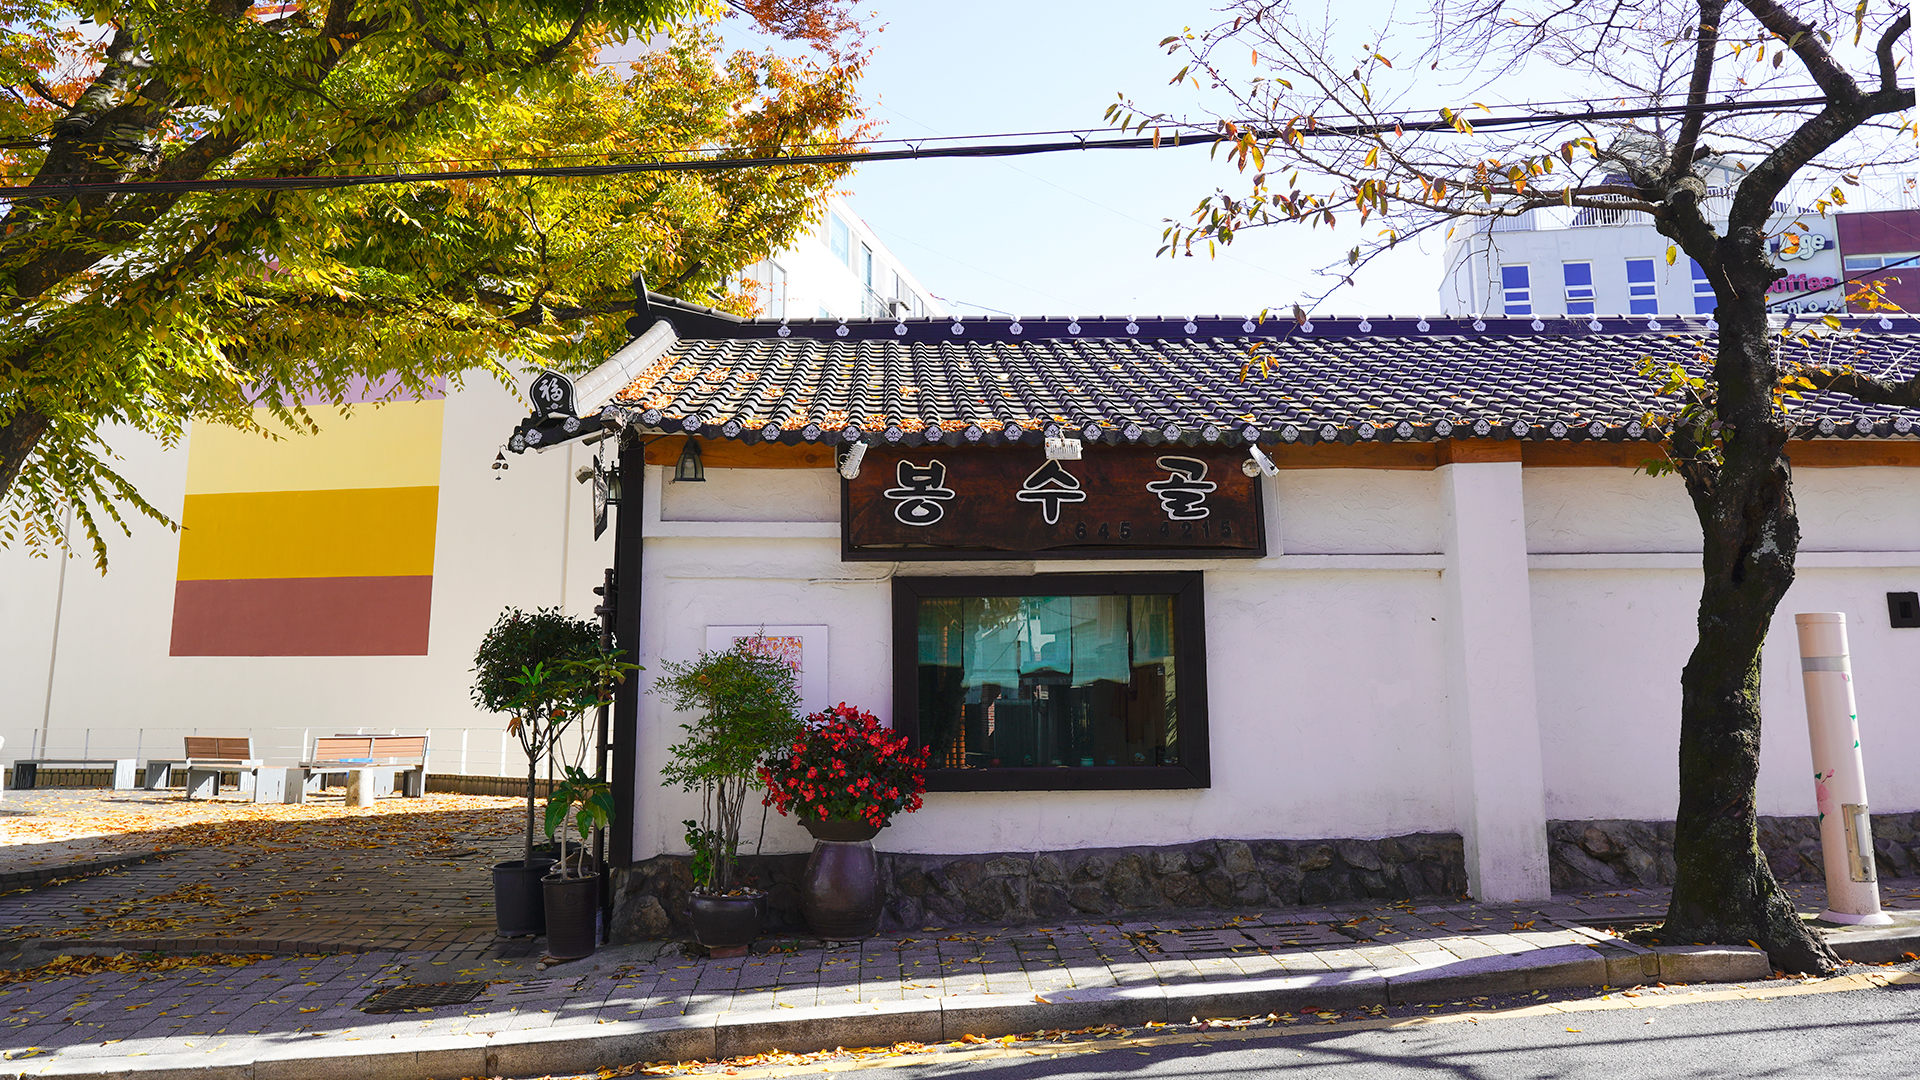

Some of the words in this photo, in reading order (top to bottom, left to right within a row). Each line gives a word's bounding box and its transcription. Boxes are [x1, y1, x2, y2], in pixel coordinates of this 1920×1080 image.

[1765, 274, 1835, 294] offee
[539, 377, 564, 402] 福
[883, 455, 1218, 526] 봉수골
[1074, 520, 1133, 541] 645
[1158, 519, 1234, 540] 4215
